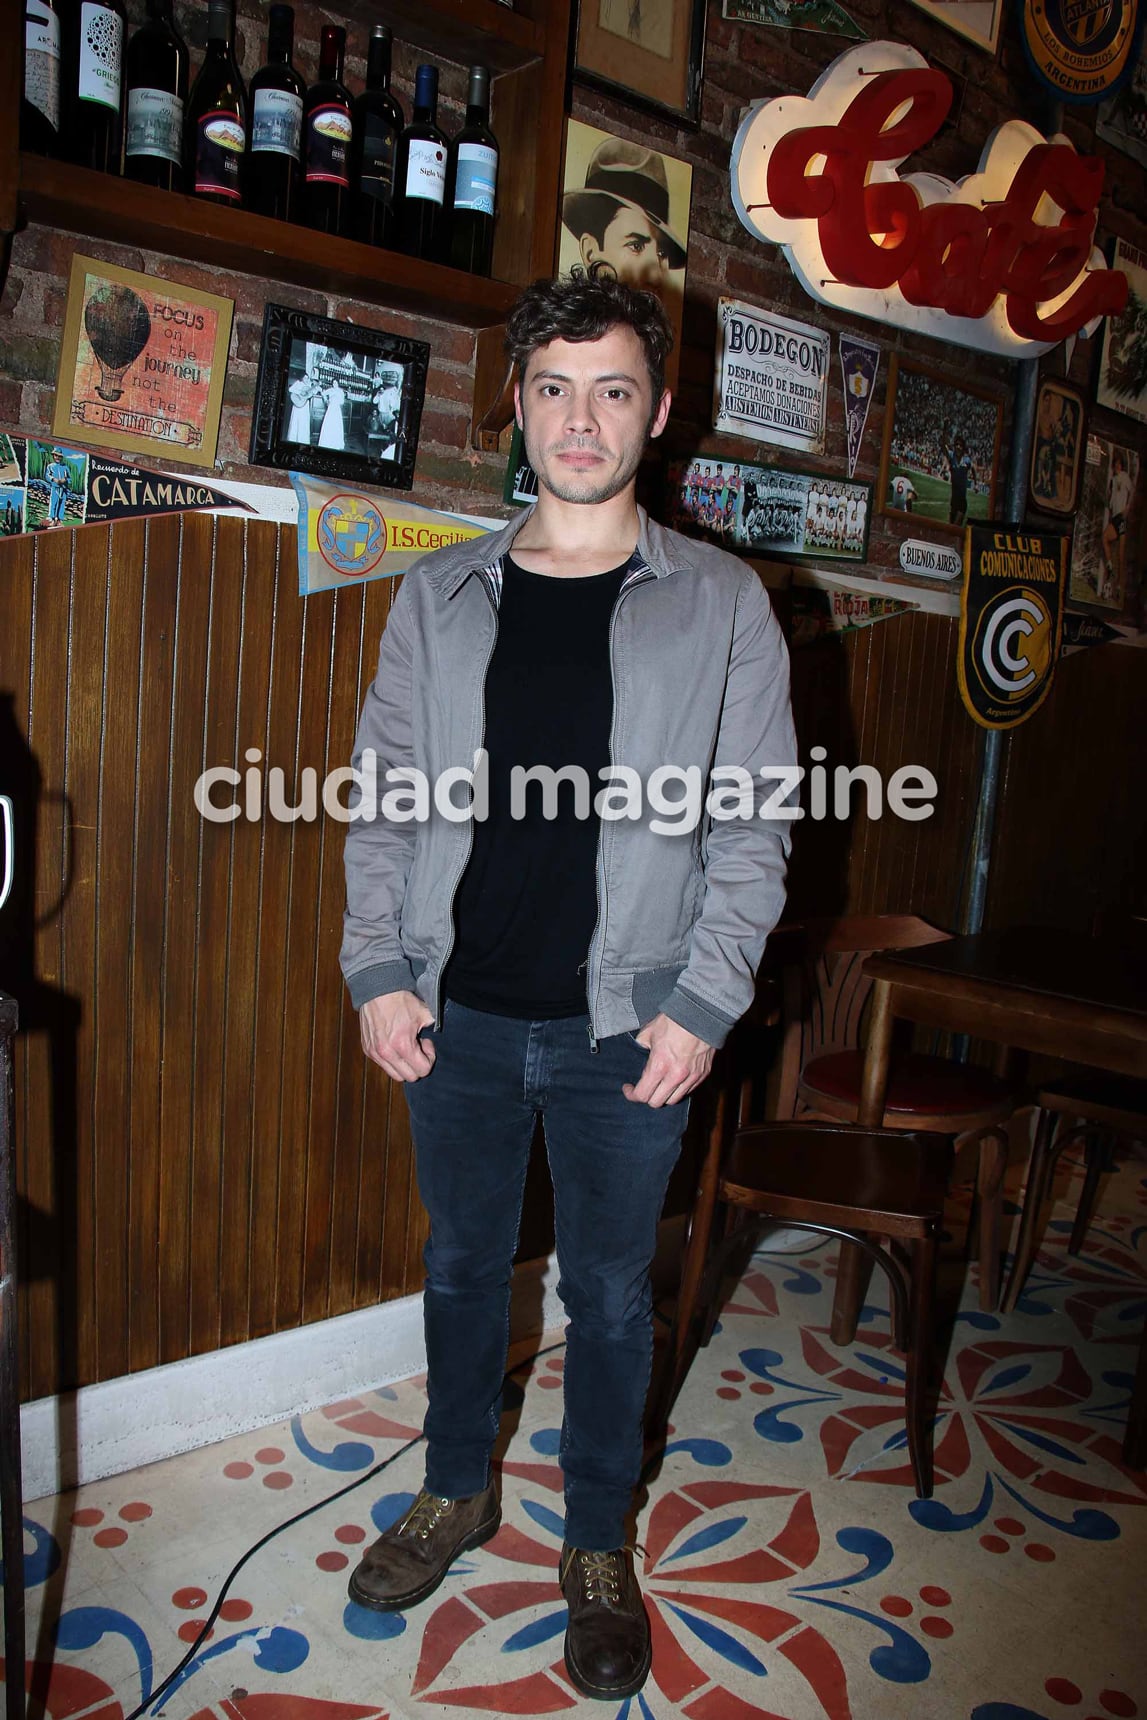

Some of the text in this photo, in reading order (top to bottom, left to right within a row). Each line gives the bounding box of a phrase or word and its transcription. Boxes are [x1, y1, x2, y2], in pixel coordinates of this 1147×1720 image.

[1044, 32, 1060, 53] LOS
[1045, 61, 1106, 91] ARGENTINA
[154, 304, 204, 330] FOCUS
[164, 328, 182, 341] on
[728, 319, 824, 376] BODEGON
[169, 344, 197, 361] the
[144, 353, 201, 385] journey
[133, 375, 161, 391] not
[728, 364, 821, 402] DESPACHO DE BEBIDAS
[149, 398, 177, 412] the
[725, 395, 773, 422] ABSTEMIOS
[727, 380, 821, 418] ACEPTAMOS DONACIONES
[102, 408, 172, 437] DESTINATION
[91, 457, 140, 476] Recuerdo de
[92, 475, 215, 507] CATAMARCA
[391, 525, 472, 549] I.S.Cecili
[994, 533, 1043, 555] CLUB
[906, 547, 957, 573] BUENOS AIRES
[980, 550, 1056, 583] COMUNICACIONES
